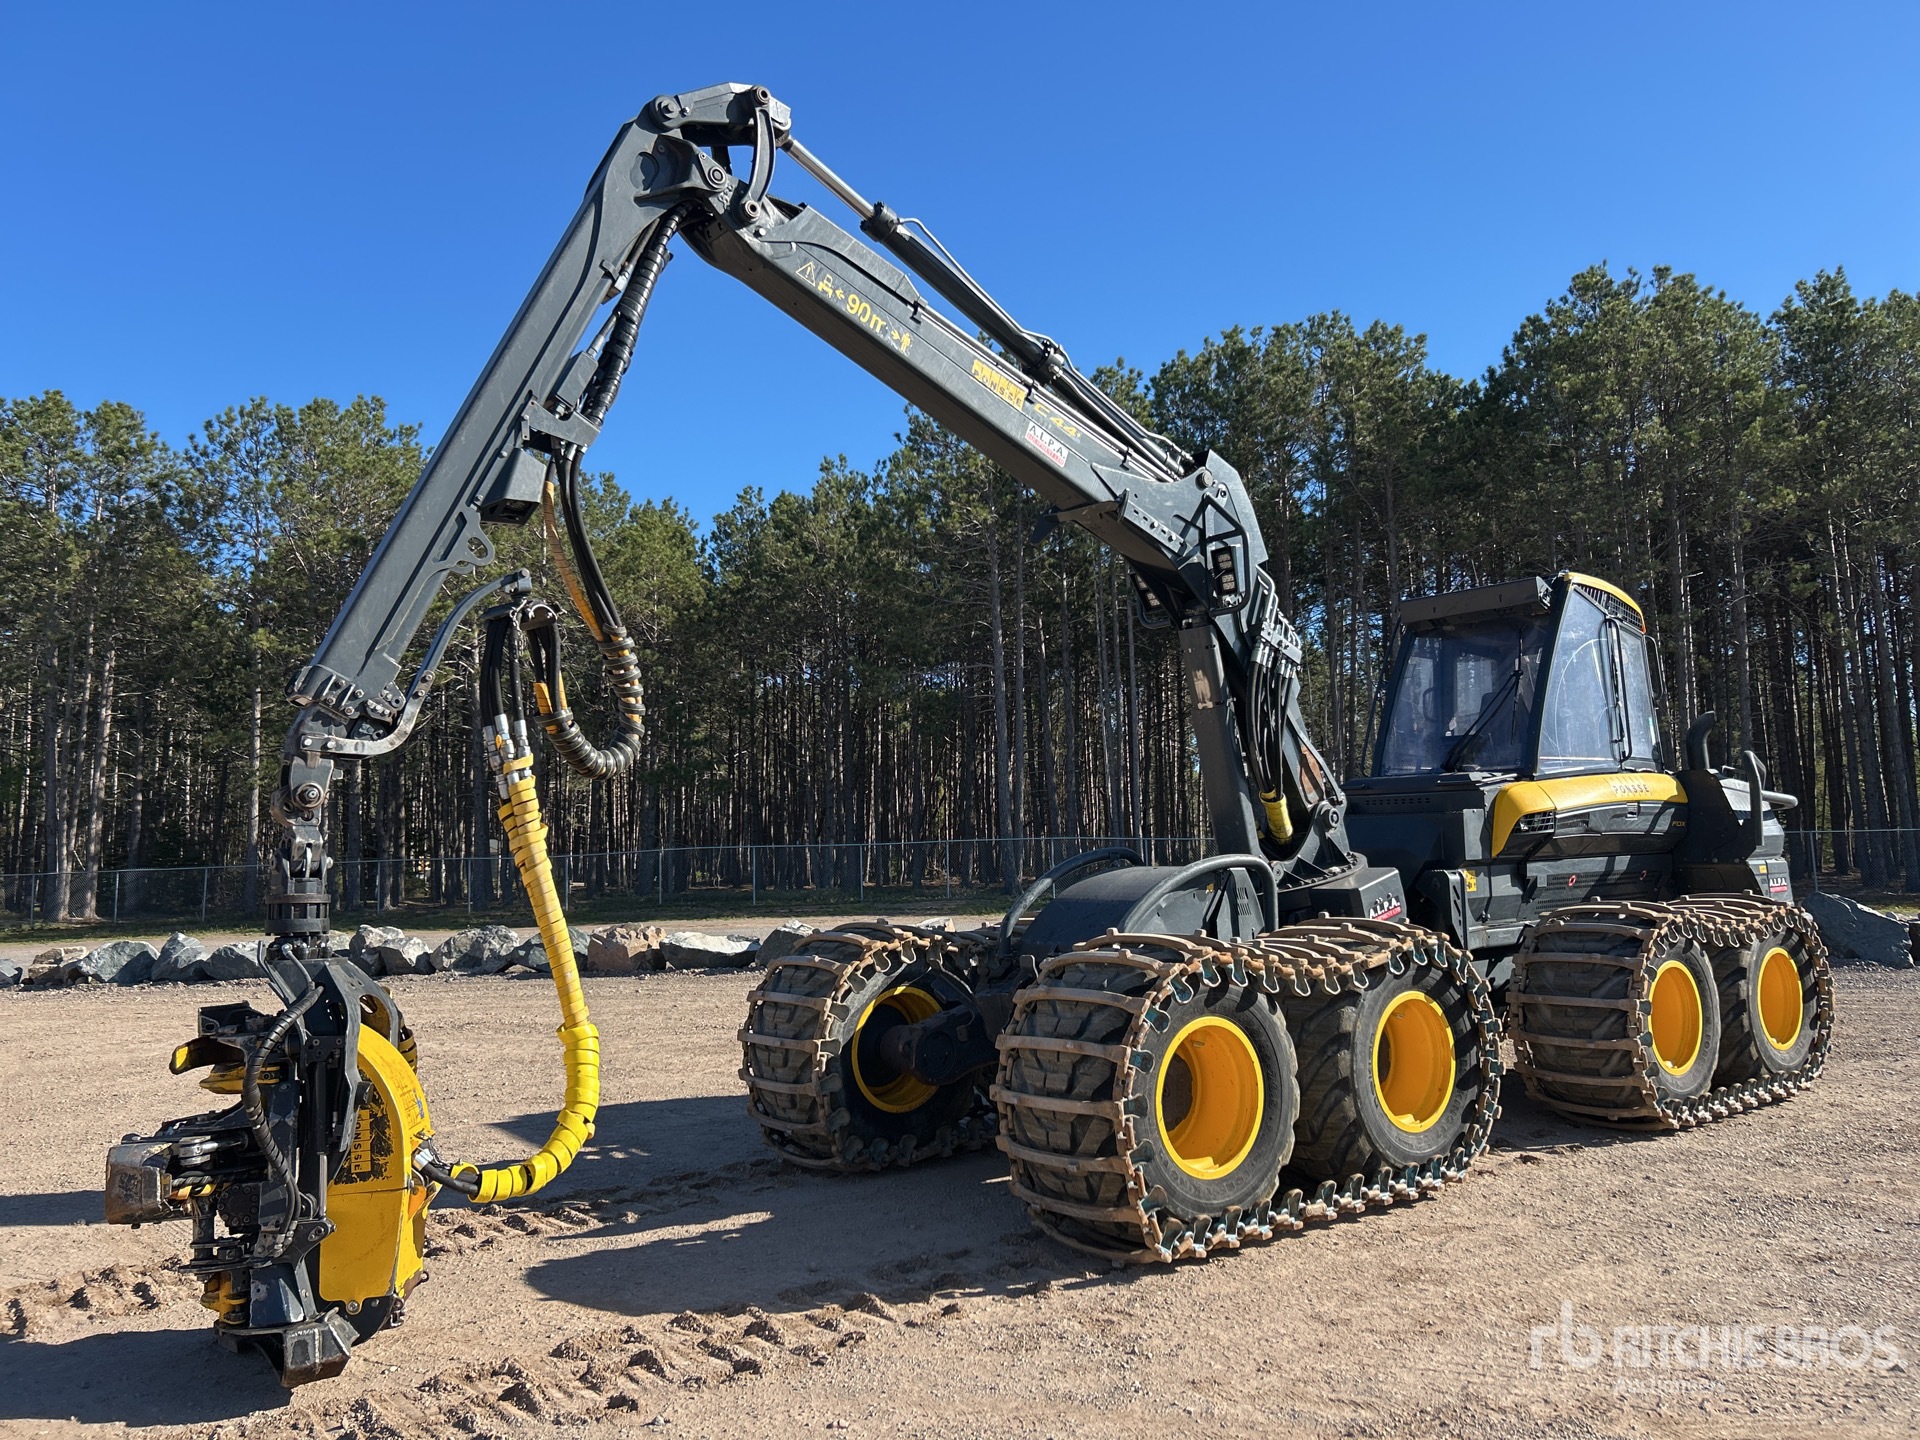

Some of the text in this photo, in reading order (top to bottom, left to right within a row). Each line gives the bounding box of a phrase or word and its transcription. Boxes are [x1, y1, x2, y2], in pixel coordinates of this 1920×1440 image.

[973, 368, 1022, 408] PONSSE
[1029, 425, 1066, 459] A.L.P.A.
[1612, 784, 1650, 795] PONSSE
